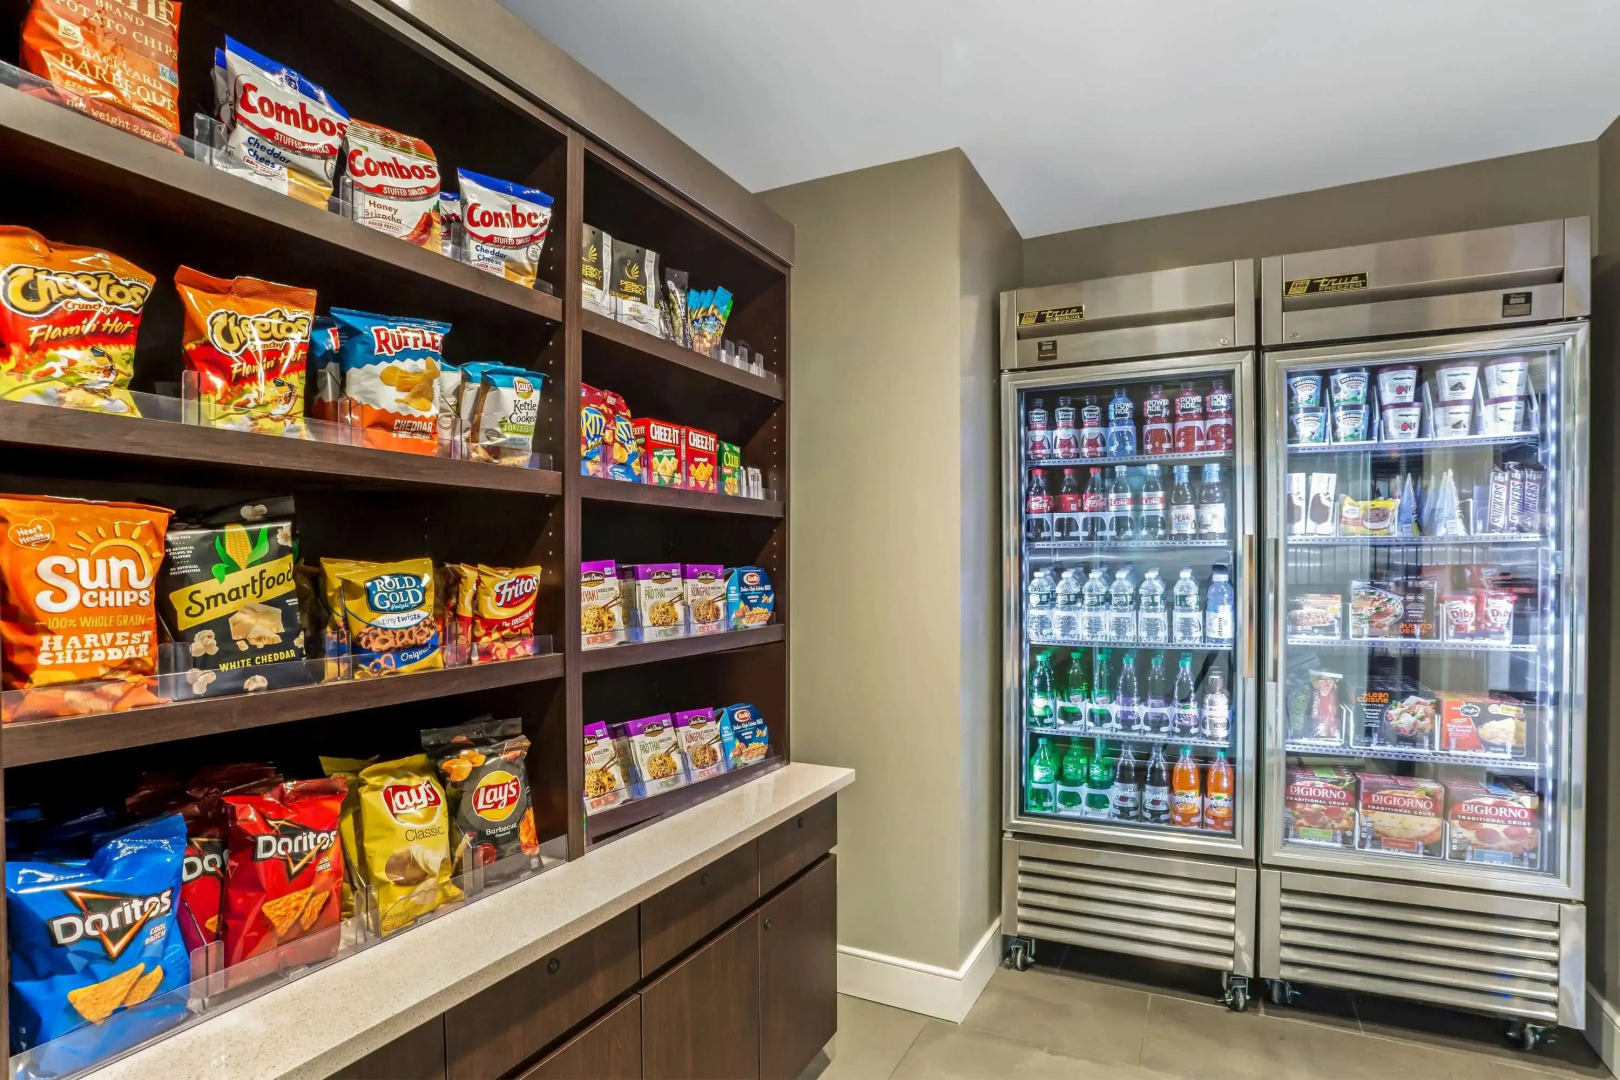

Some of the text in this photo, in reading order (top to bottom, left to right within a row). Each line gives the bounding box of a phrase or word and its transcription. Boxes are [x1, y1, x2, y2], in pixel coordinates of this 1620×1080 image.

[95, 0, 145, 26] BRAND
[132, 31, 178, 60] CHIPS
[80, 45, 163, 89] BACKYARD
[60, 52, 177, 114] BARBEQUE
[66, 98, 88, 112] net
[91, 108, 131, 130] weight
[133, 124, 139, 132] 2
[140, 128, 152, 139] oz
[239, 82, 348, 141] Combos
[274, 132, 302, 150] STUFFED
[247, 136, 292, 164] Cheddar
[347, 148, 437, 180] Combos
[383, 186, 408, 197] STUFFED
[368, 199, 399, 215] Honey
[466, 202, 549, 229] Combos
[364, 209, 402, 225] Sriracha
[492, 236, 515, 246] STUFFED
[475, 244, 507, 259] Cheddar
[7, 266, 148, 313] Cheetos
[620, 279, 646, 290] PERKY
[620, 286, 646, 296] JERKY
[1318, 282, 1363, 292] FREEZER
[64, 300, 113, 315] Crunchy
[28, 316, 135, 347] Flamin' Hot
[211, 310, 310, 352] Cheetos
[514, 380, 533, 393] Lay's
[512, 400, 537, 414] Kettle
[393, 419, 433, 433] CHEDDAR
[650, 422, 680, 445] CHEEZ-IT
[688, 430, 716, 453] CHEEZ-IT
[1111, 498, 1129, 507] Coke
[1143, 497, 1161, 505] Coke
[1491, 484, 1505, 525] SNICKERS
[16, 523, 44, 537] Heart
[18, 531, 51, 546] Healthy
[35, 555, 154, 614] Sun
[184, 563, 294, 619] Smartfood
[375, 575, 417, 593] ROLD
[494, 575, 538, 607] Fritos
[690, 586, 702, 597] KUNG
[82, 590, 151, 608] CHIPS
[373, 588, 424, 610] GOLD
[645, 588, 666, 600] PAD THAI
[47, 613, 146, 630] 100% WHOLE GRAIN
[381, 612, 422, 626] tiny twists
[511, 608, 535, 626] ORIGINAL
[1450, 609, 1475, 620] Dibs
[39, 630, 153, 652] HARVEST
[37, 644, 150, 666] CHEDDAR
[219, 649, 297, 672] WHITE CHEDDAR
[400, 643, 433, 662] Original
[684, 732, 695, 744] KUNG
[639, 742, 661, 755] PAD THAI
[387, 781, 436, 814] Lay's
[477, 780, 518, 810] Lay's
[1286, 796, 1327, 805] TRADITIONAL
[1289, 785, 1347, 800] DIGIORNO
[1367, 804, 1413, 815] TRADITIONAL
[1372, 794, 1434, 810] DIGIORNO
[1457, 814, 1507, 825] TRADITIONAL
[1461, 803, 1530, 820] DIGIORNO
[404, 825, 445, 842] Classic
[485, 822, 518, 836] Barbecue
[256, 829, 338, 860] Doritos
[52, 888, 173, 945] Doritos
[144, 929, 167, 945] RANCH
[149, 923, 167, 935] COOL
